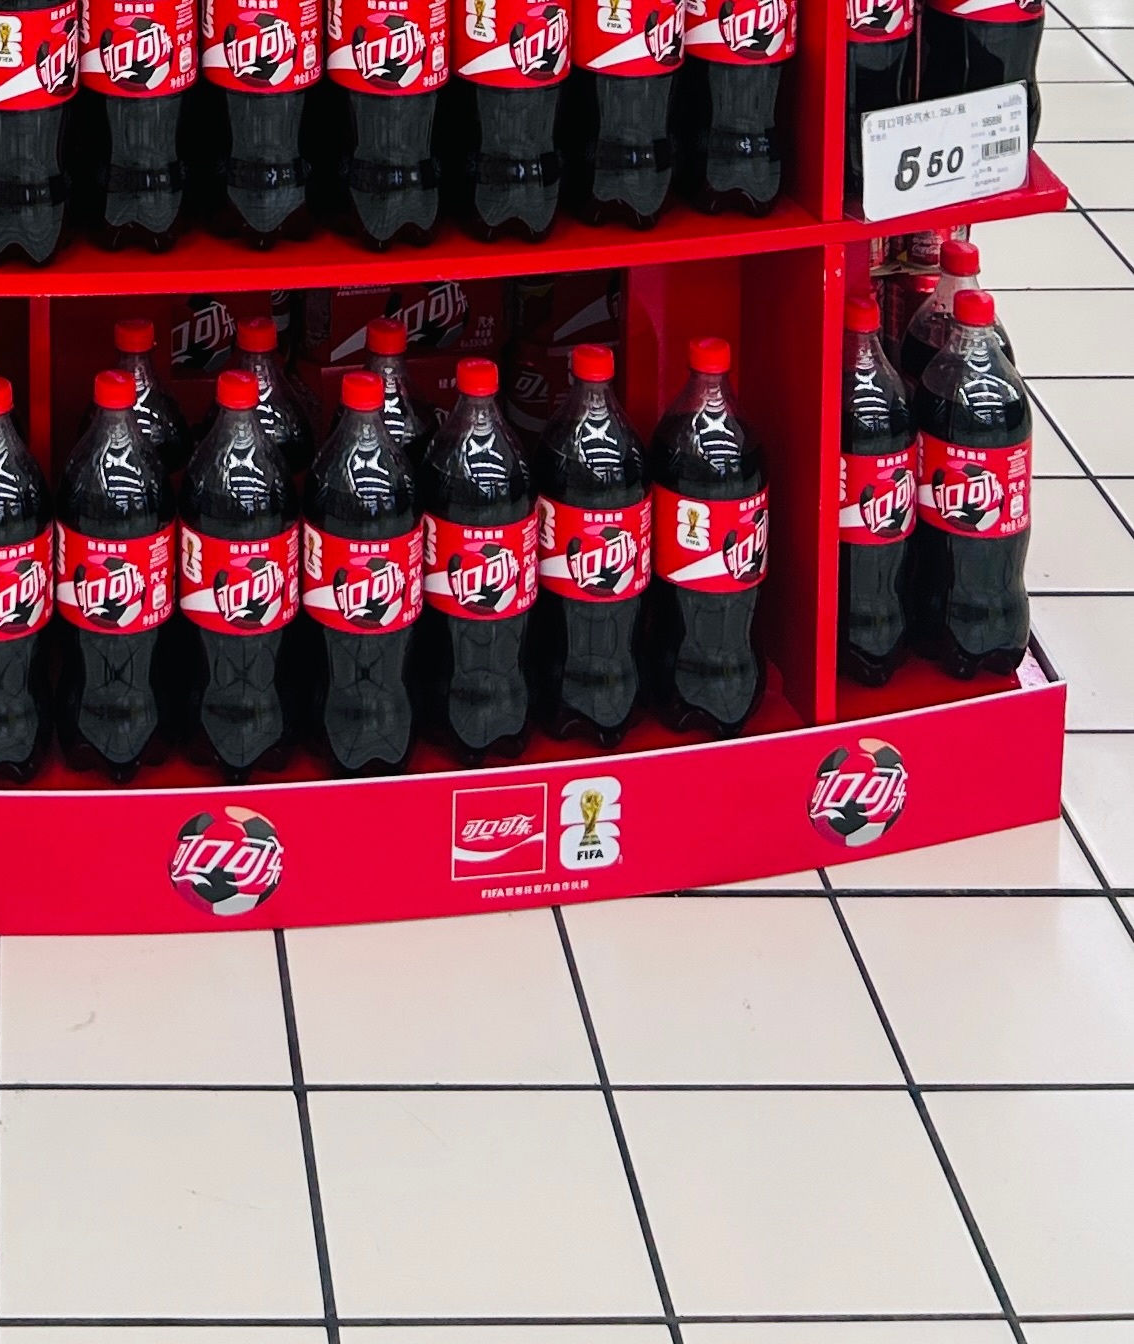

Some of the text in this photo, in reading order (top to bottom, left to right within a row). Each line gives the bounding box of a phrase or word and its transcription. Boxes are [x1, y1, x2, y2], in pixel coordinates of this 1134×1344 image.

[811, 763, 908, 820] 可口可乐
[461, 814, 536, 842] 可口可乐
[170, 835, 284, 886] 可口可乐
[577, 849, 604, 861] FIFA
